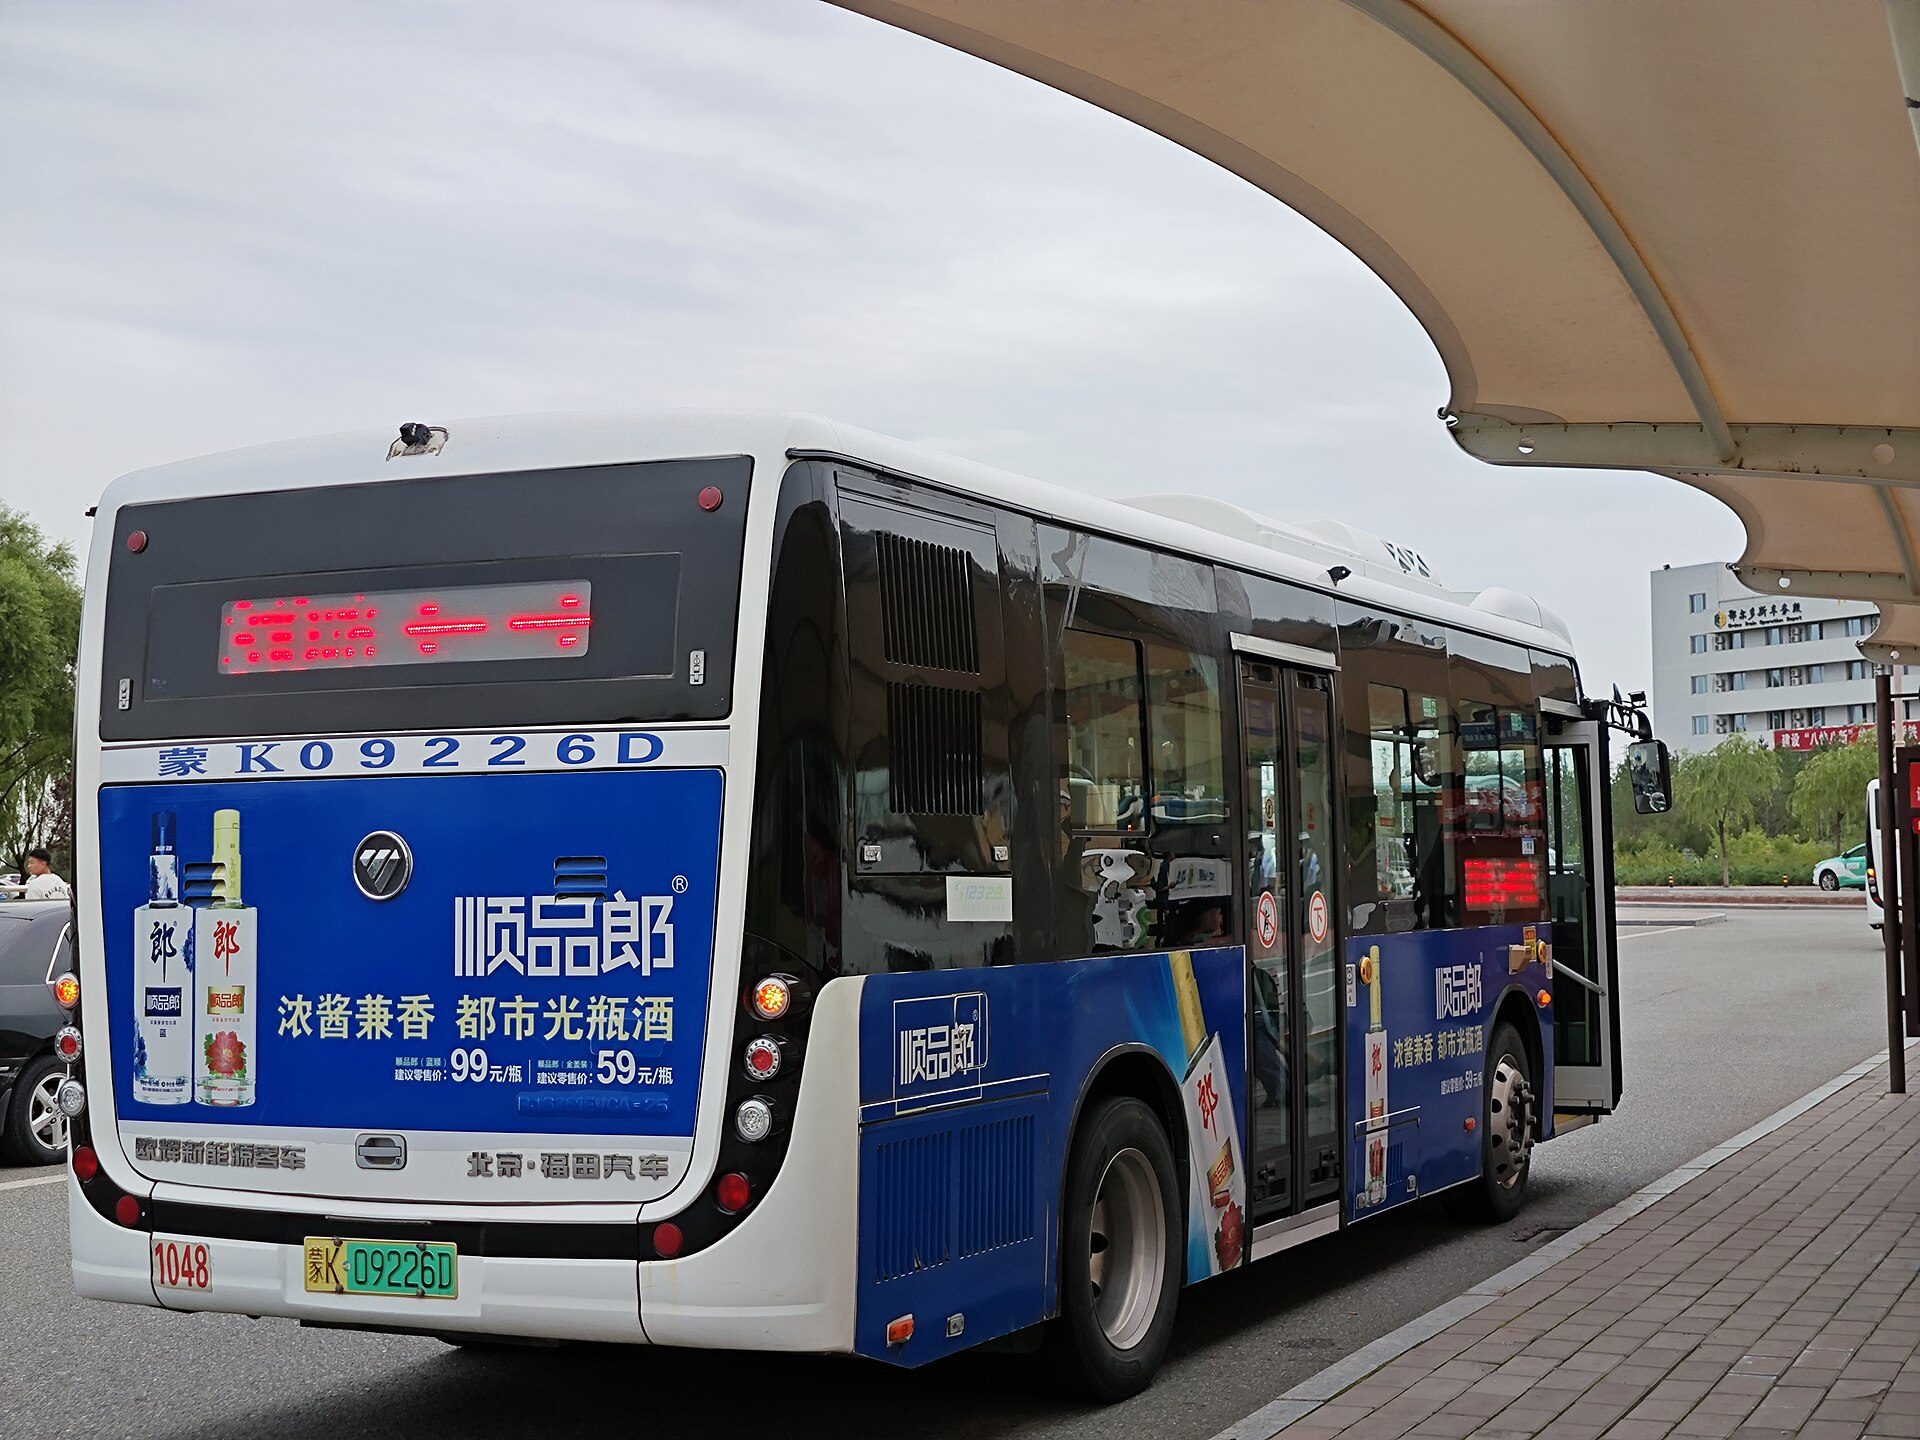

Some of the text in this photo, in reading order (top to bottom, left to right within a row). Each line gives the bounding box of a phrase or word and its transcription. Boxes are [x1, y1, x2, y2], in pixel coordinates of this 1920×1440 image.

[454, 890, 674, 977] 顺品郎
[1313, 907, 1323, 932] 下
[150, 920, 177, 983] 郎
[213, 920, 240, 977] 郎
[146, 994, 180, 1011] 顺品郎
[1436, 962, 1483, 1020] 顺品郎
[277, 993, 674, 1042] 浓酱兼香 都市光瓶酒
[900, 1022, 975, 1085] 顺品郎
[1393, 1024, 1483, 1069] 浓酱兼香 都市光瓶酒
[135, 1136, 306, 1171] 欧辉新能源客车
[154, 1241, 209, 1288] 1048
